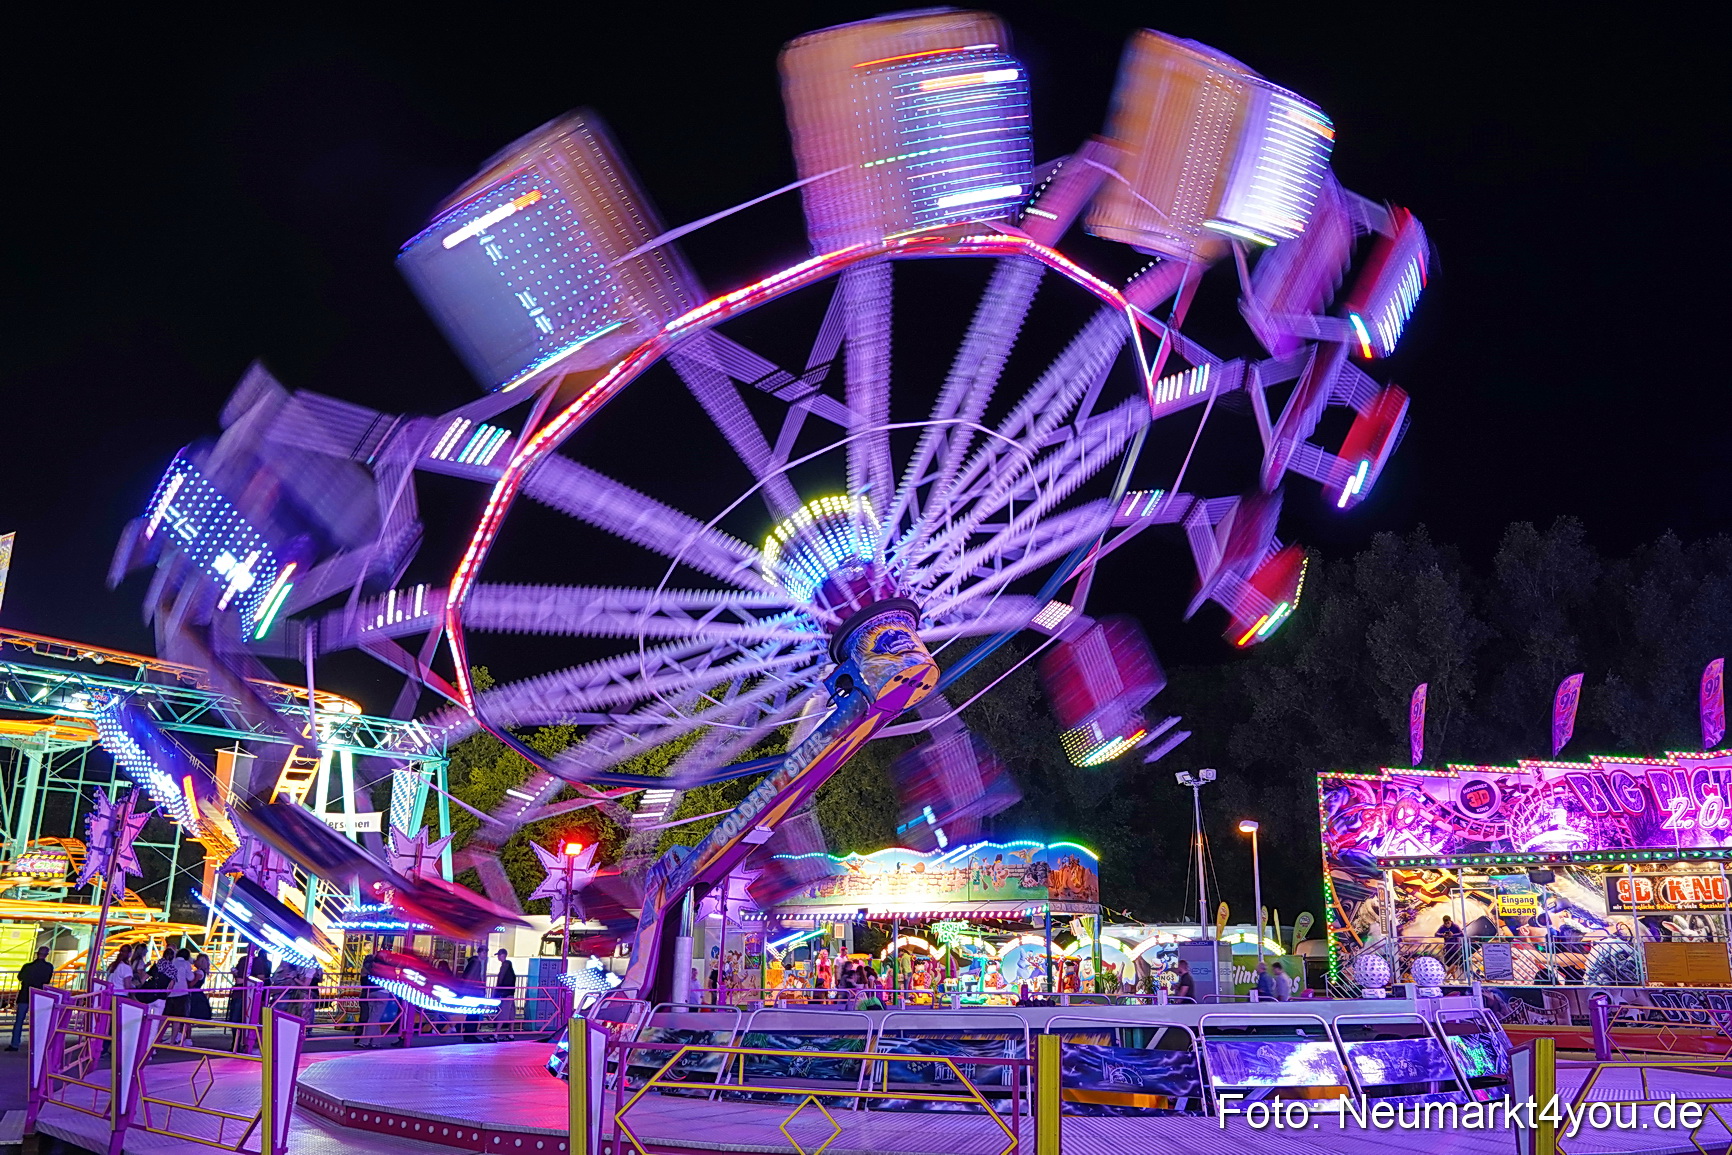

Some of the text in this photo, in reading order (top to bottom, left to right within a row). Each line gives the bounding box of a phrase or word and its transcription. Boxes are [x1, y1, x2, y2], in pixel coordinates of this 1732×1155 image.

[712, 731, 832, 846] GOLDEN STAR
[1466, 789, 1490, 808] 3D
[1566, 770, 1646, 817] BIG
[1501, 896, 1535, 905] Eingang
[1666, 875, 1731, 903] KINO
[1501, 907, 1537, 916] Ausgang
